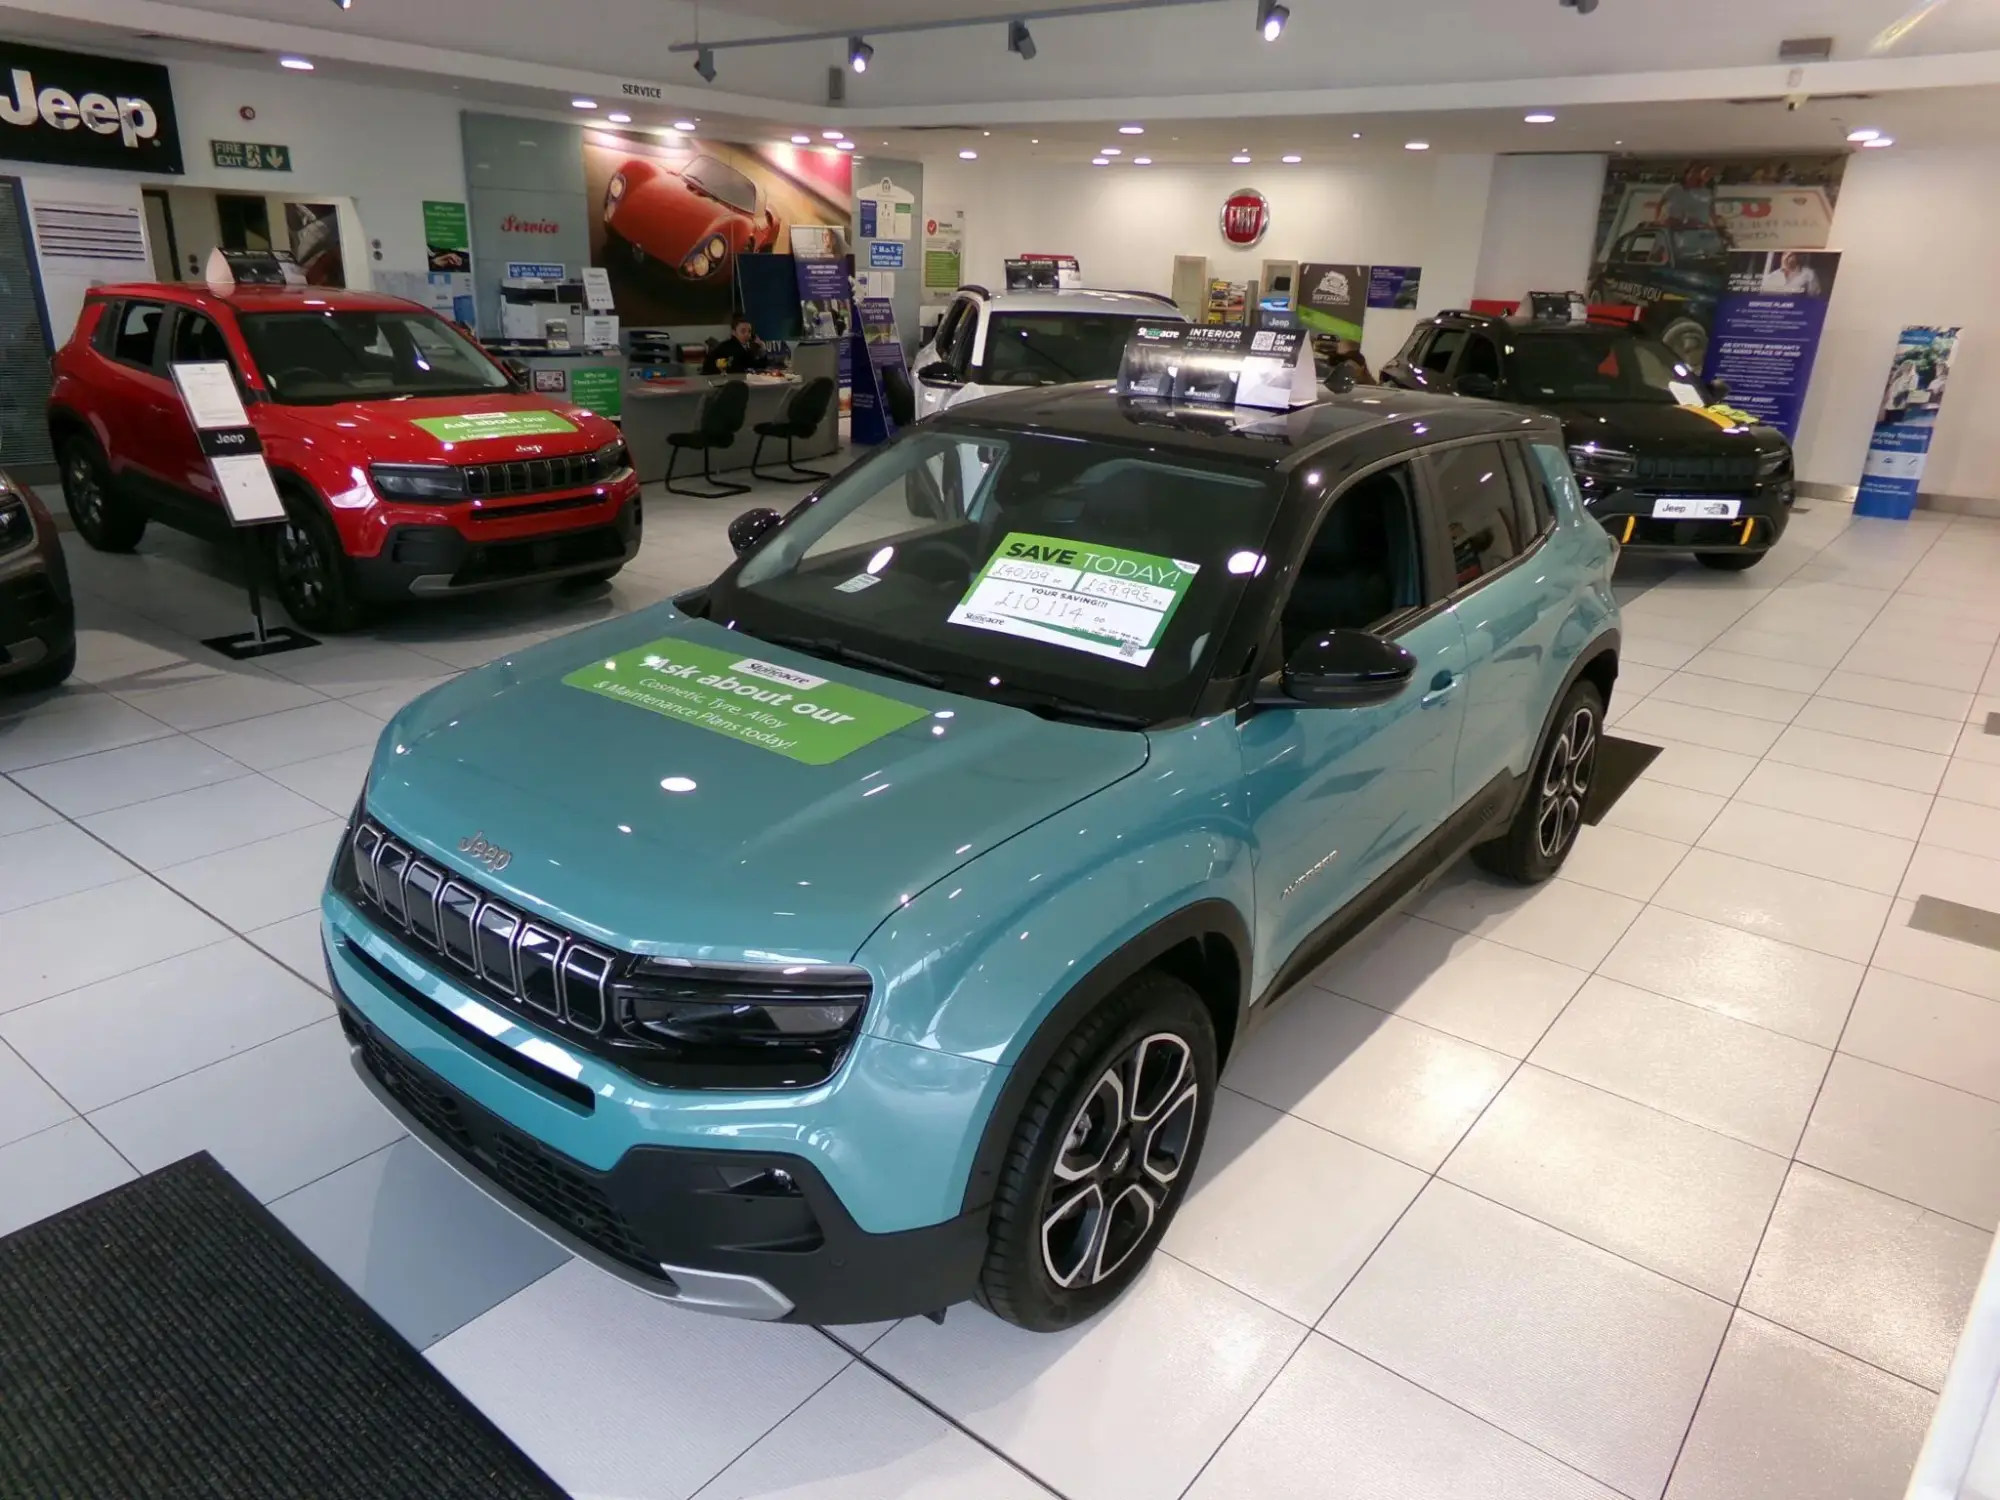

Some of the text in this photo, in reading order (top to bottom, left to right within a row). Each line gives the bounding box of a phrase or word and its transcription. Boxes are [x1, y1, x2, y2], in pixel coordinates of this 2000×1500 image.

[622, 84, 661, 98] SERVICE
[0, 69, 157, 148] Jeep
[215, 143, 242, 154] FIRE
[217, 155, 243, 166] EXIT
[502, 214, 560, 234] Service
[1230, 206, 1260, 233] FIAT
[1269, 317, 1289, 327] Jeep
[1189, 328, 1242, 339] INTERIOR
[216, 433, 246, 445] Jeep
[1662, 504, 1686, 513] Jeep
[1005, 542, 1181, 588] SAVE TODAY!
[1031, 587, 1109, 609] YOUR SAVING!!!
[963, 612, 1005, 626] Stoneacre
[747, 662, 810, 686] Stoneacre
[638, 655, 855, 726] Ask about our
[593, 679, 798, 750] & Maintenance Plans today!
[742, 709, 789, 730] Alloy
[458, 831, 513, 873] Jeep
